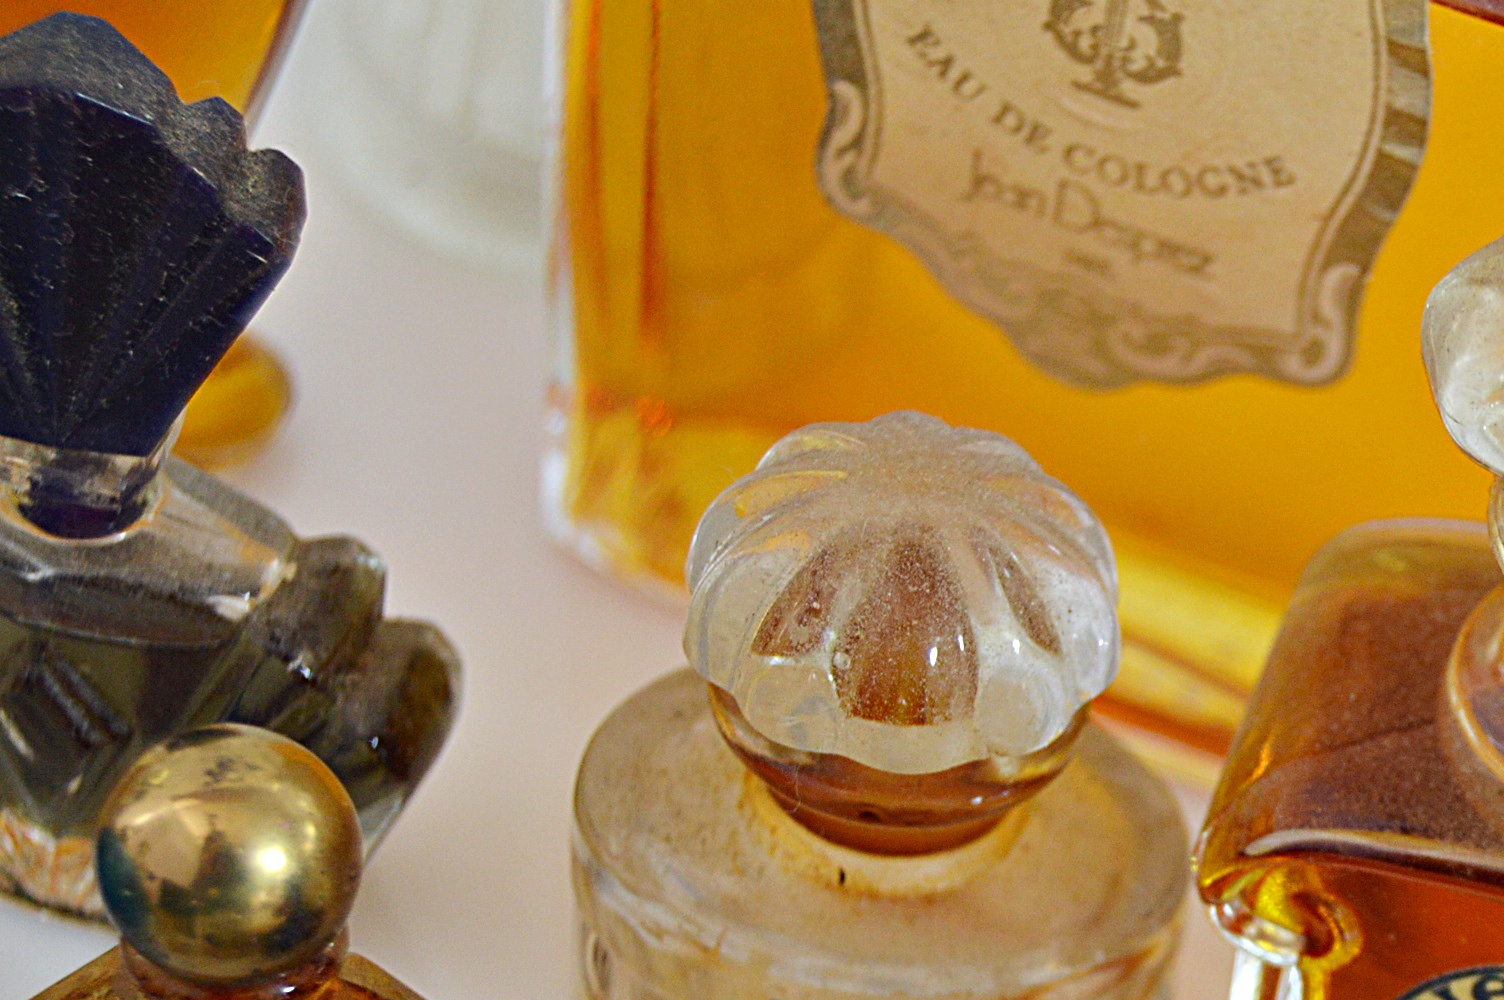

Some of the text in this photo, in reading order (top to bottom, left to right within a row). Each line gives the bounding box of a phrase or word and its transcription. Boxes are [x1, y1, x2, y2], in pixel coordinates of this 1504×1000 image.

[907, 23, 1296, 200] EAU DE COLOGNE
